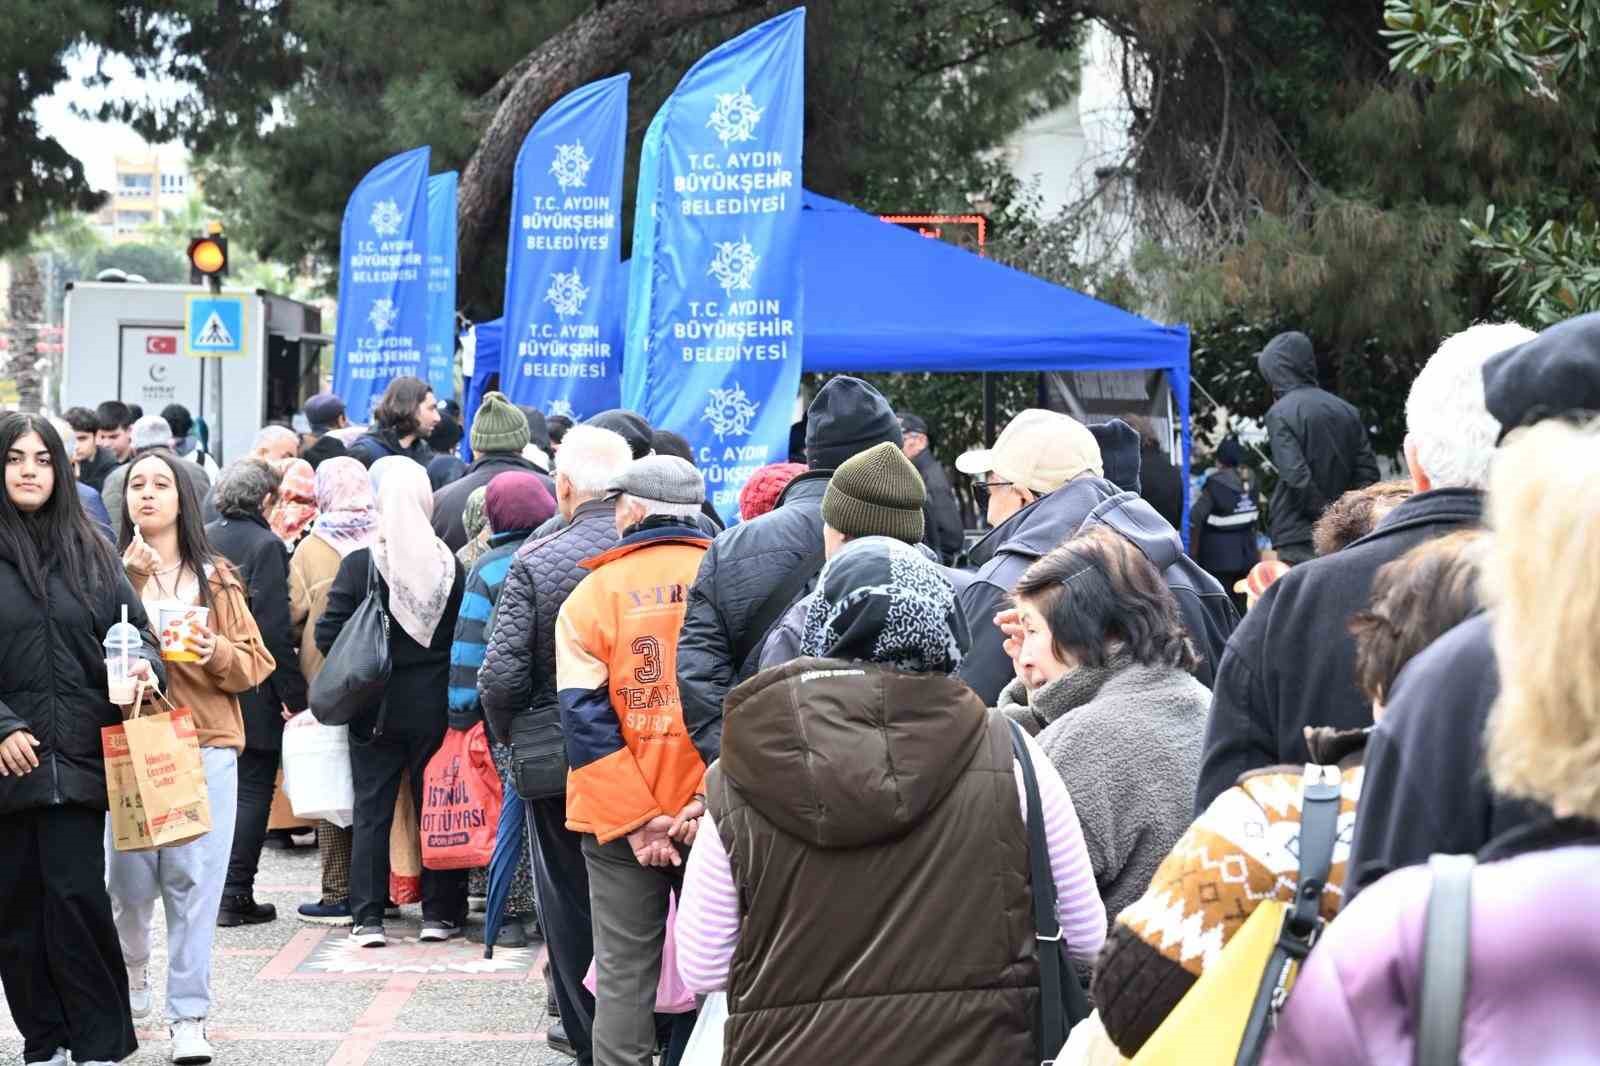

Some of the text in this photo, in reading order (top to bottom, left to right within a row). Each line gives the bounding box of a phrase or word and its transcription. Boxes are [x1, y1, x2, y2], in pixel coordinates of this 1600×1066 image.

[688, 152, 783, 170] T.C. AYDIN
[674, 168, 793, 194] BÜYÜKŞEHİR
[533, 196, 610, 211] T.C. AYDIN
[682, 193, 785, 216] BELEDİYESİ
[522, 212, 615, 234] BÜYÜKŞEHİR
[688, 299, 780, 318] T.C. AYDIN
[529, 324, 599, 339] T.C. AYDIN
[674, 318, 794, 343] BÜYÜKŞEHİR
[519, 339, 611, 360] BÜYÜKŞEHİR
[682, 340, 788, 363] BELEDİYESİ
[523, 361, 606, 378] BELEDİYESİ
[631, 635, 661, 683] 3
